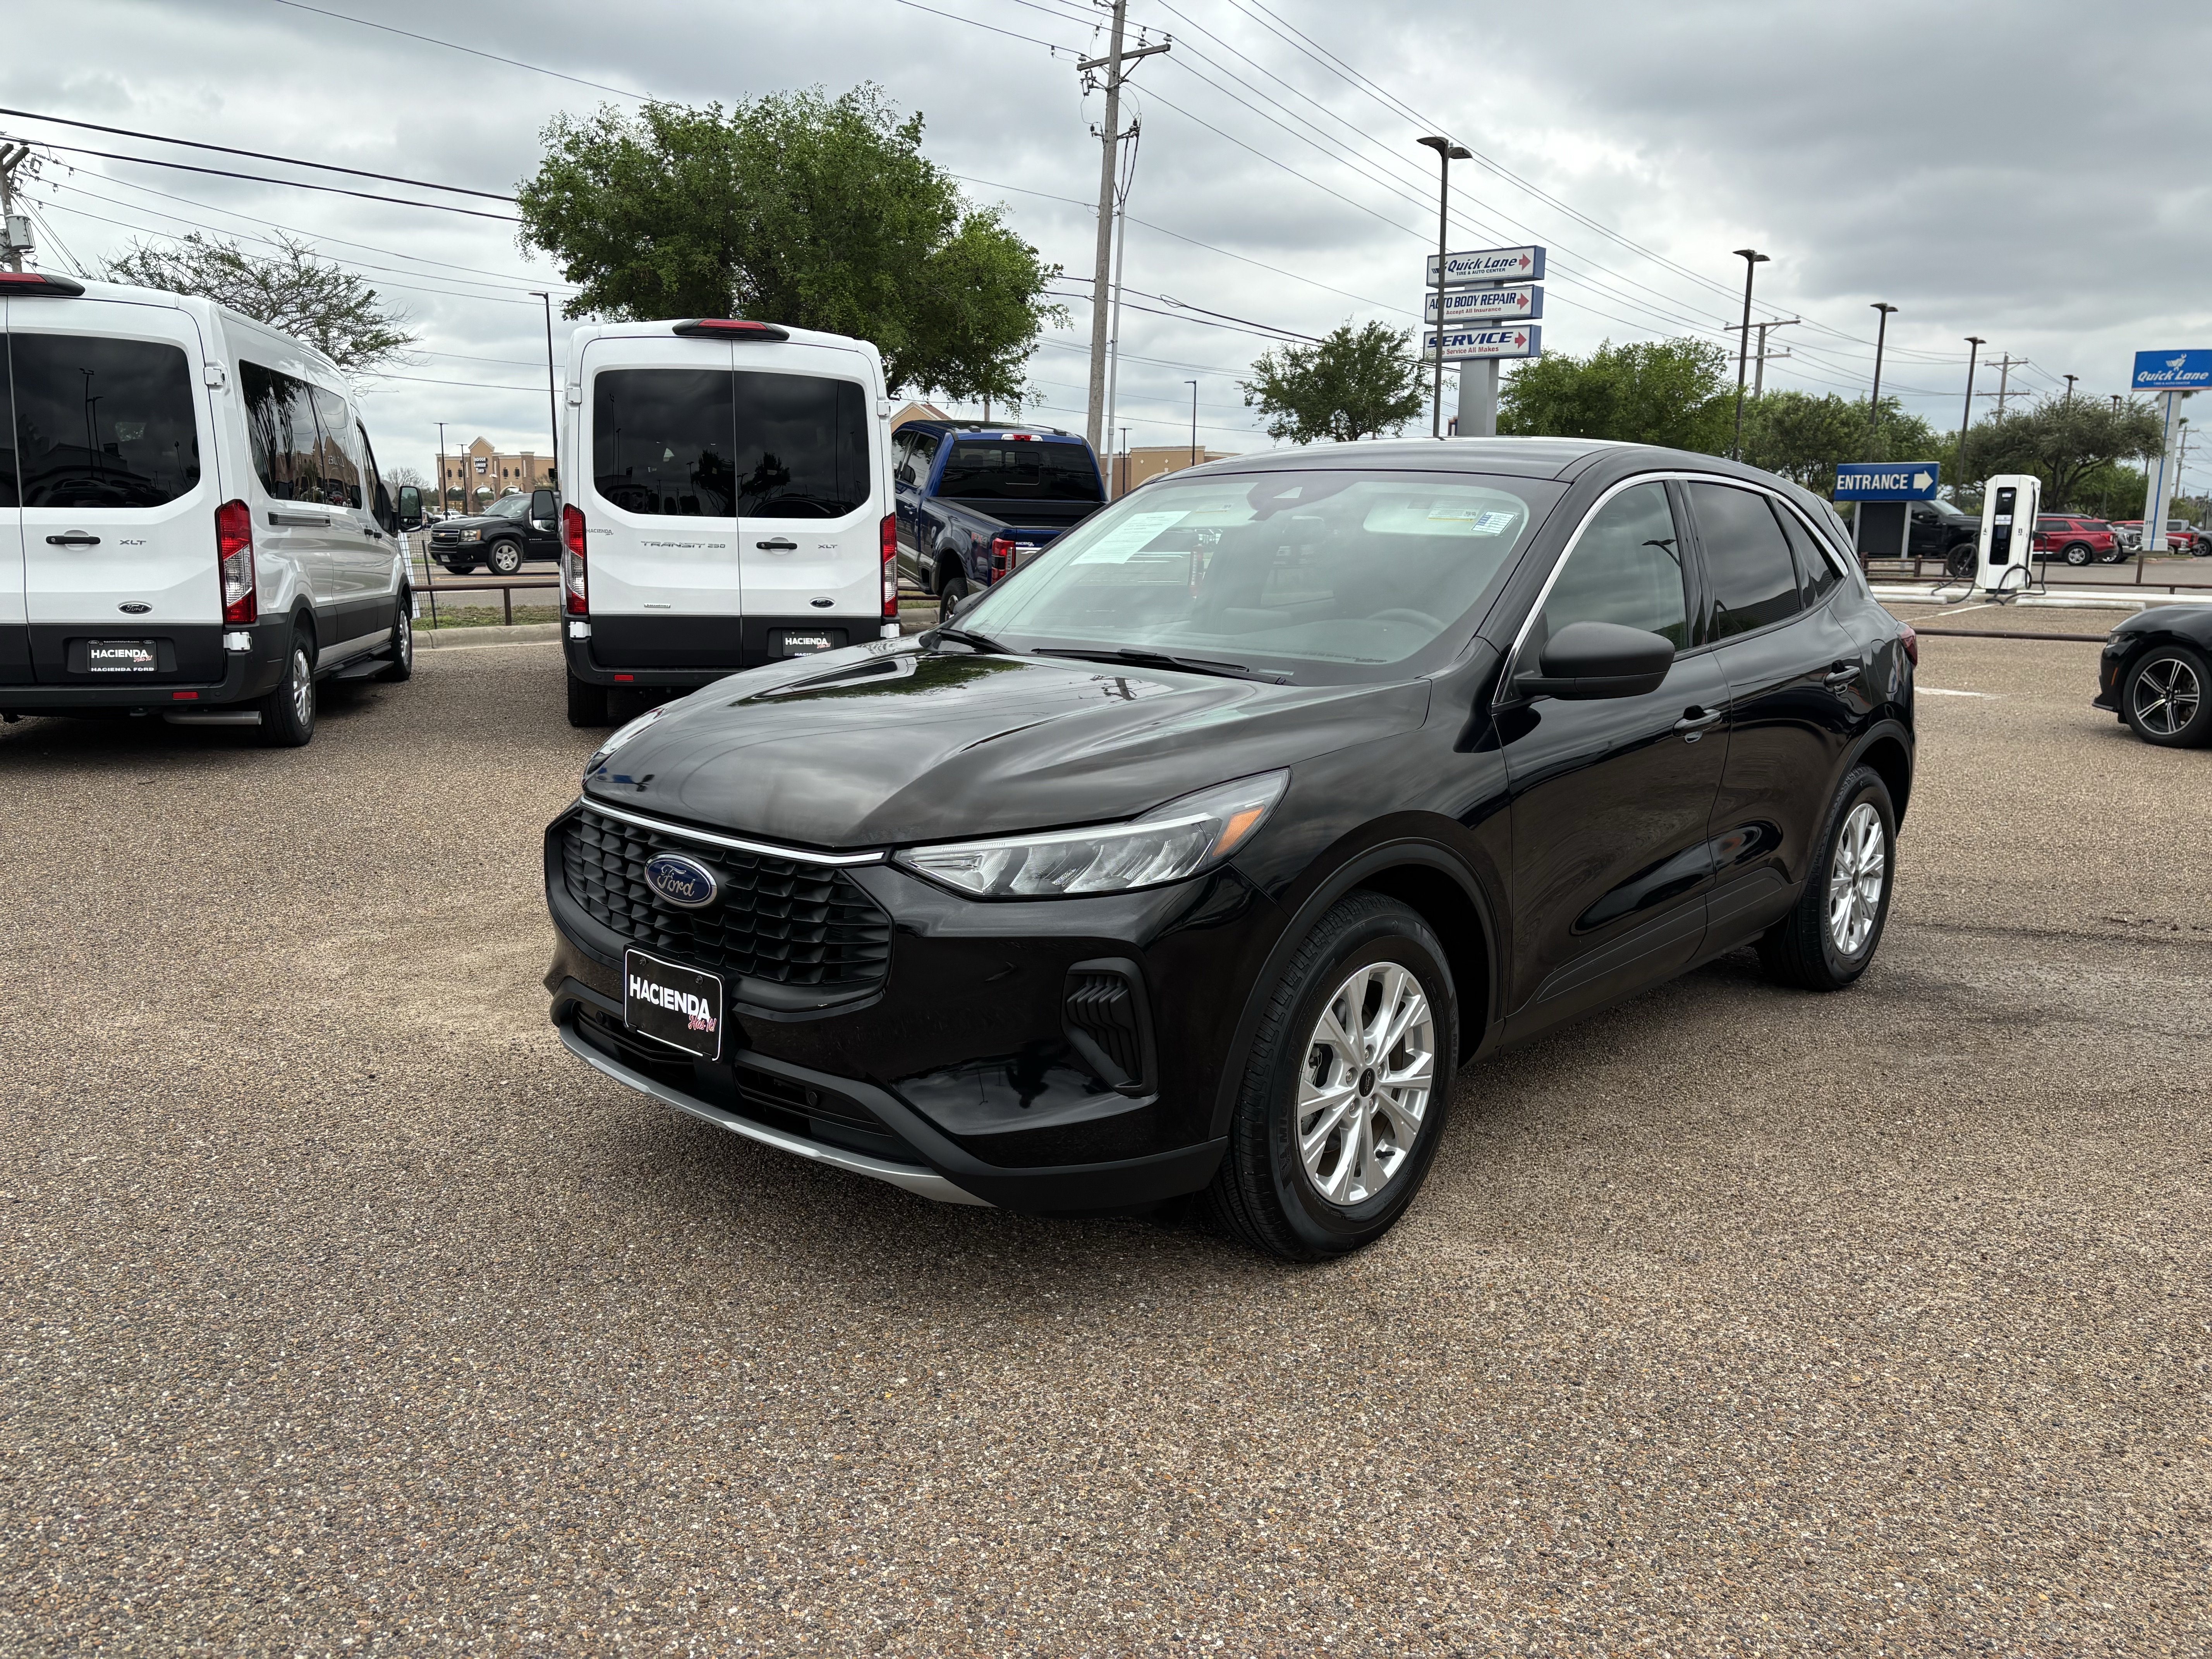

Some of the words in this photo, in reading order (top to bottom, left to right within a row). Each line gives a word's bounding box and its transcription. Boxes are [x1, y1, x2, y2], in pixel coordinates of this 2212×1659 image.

[1448, 258, 1483, 272] Quick
[1484, 257, 1517, 268] Lane
[1454, 295, 1480, 307] BODY
[1480, 292, 1516, 306] REPAIR
[1427, 331, 1513, 348] SERVICE
[2137, 370, 2174, 382] Quick
[2175, 370, 2209, 380] Lane
[1837, 474, 1909, 490] ENTRANCE
[91, 649, 148, 658] HACIENDA
[657, 864, 696, 896] Ford
[630, 974, 710, 1022] HACIENDA
[688, 1014, 706, 1030] Has
